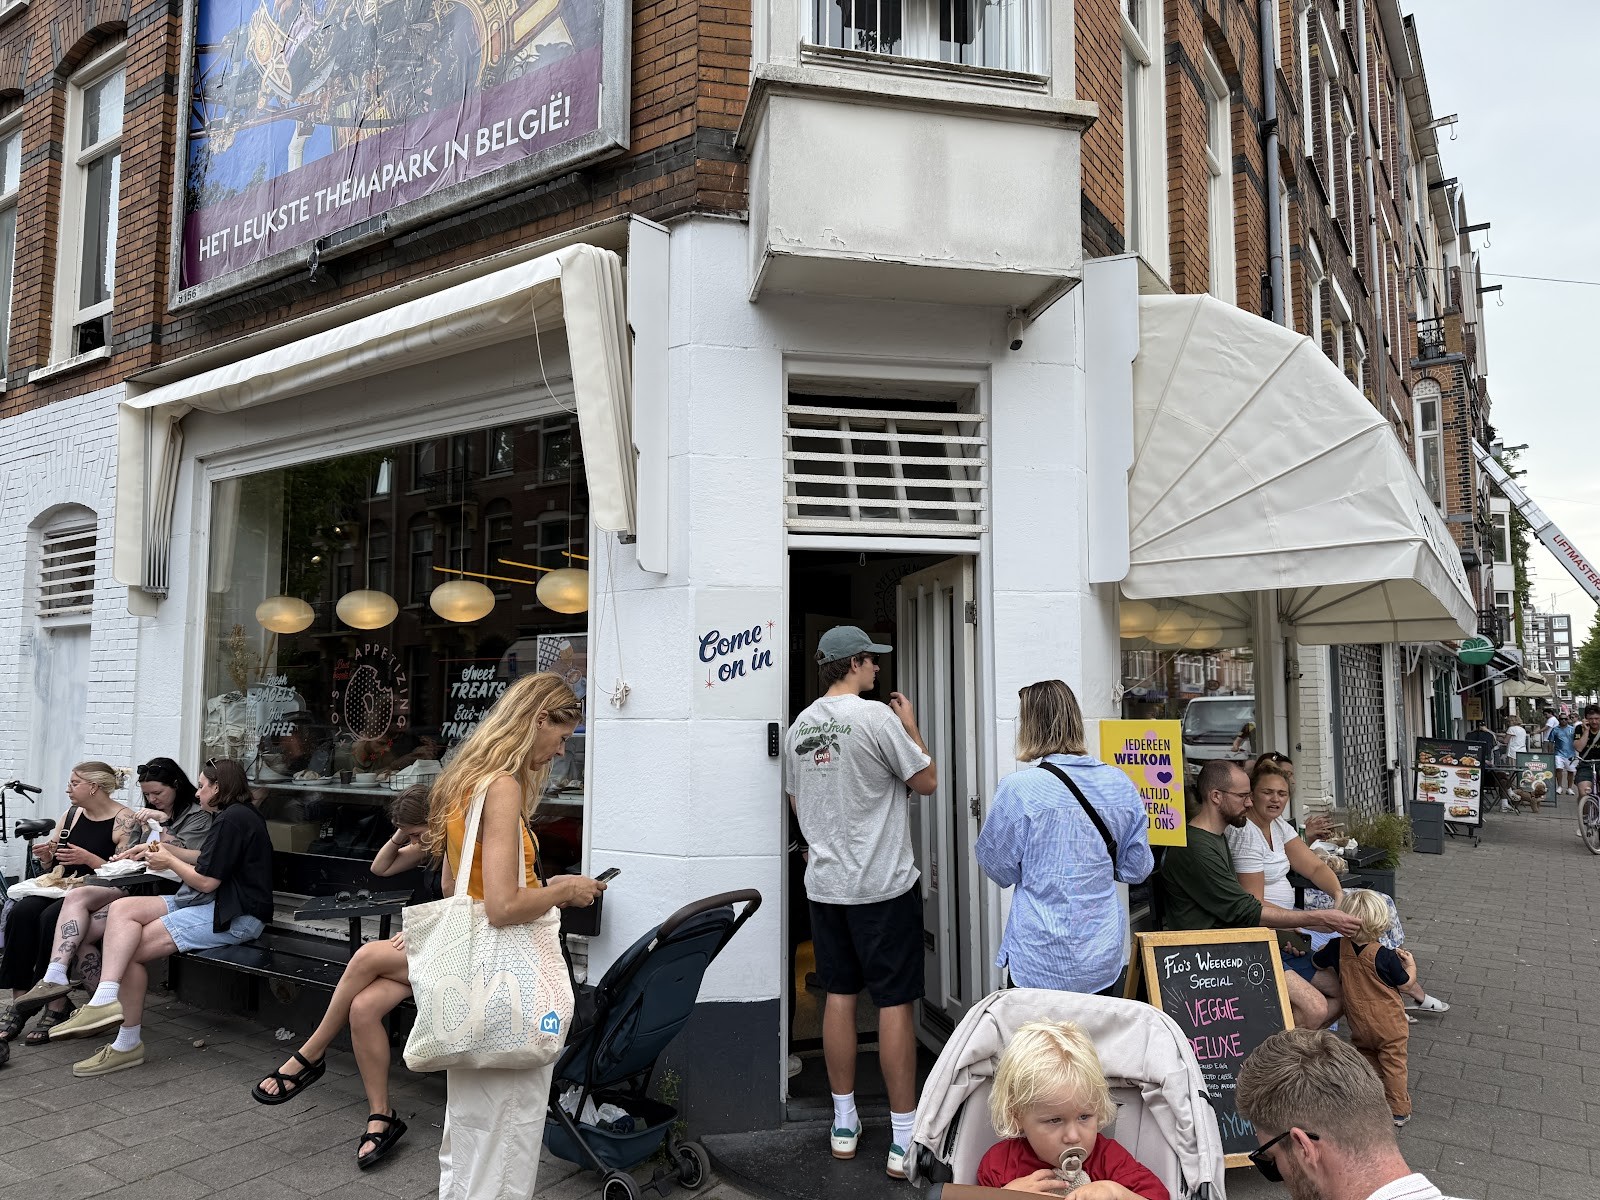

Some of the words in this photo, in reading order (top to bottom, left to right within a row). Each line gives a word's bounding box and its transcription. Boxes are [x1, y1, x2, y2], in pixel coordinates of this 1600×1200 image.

[199, 224, 230, 262] HET
[234, 197, 311, 248] LEUKSTE
[314, 146, 438, 215] THEMAPARK
[443, 138, 469, 173] IN
[475, 92, 571, 156] BELGIË!
[698, 625, 762, 663] Come
[461, 664, 496, 680] Sweet
[718, 659, 747, 682] on
[751, 647, 773, 671] in
[256, 685, 296, 702] BAGELS
[355, 643, 409, 729] APPETIZING
[451, 681, 507, 699] TREATS
[268, 706, 286, 721] Hot
[257, 721, 296, 737] COFFEE
[795, 721, 823, 741] Farm
[822, 716, 852, 735] Fresh
[1125, 738, 1171, 751] IEDEREEN
[1113, 752, 1172, 766] WELKOM
[1139, 787, 1173, 802] ALTIJD,
[1154, 817, 1175, 830] ONS
[1195, 951, 1243, 972] WEEKEND
[1189, 974, 1234, 989] SPECIAL
[1185, 996, 1244, 1028] VEGGIE
[1187, 1033, 1244, 1061] DELUXE
